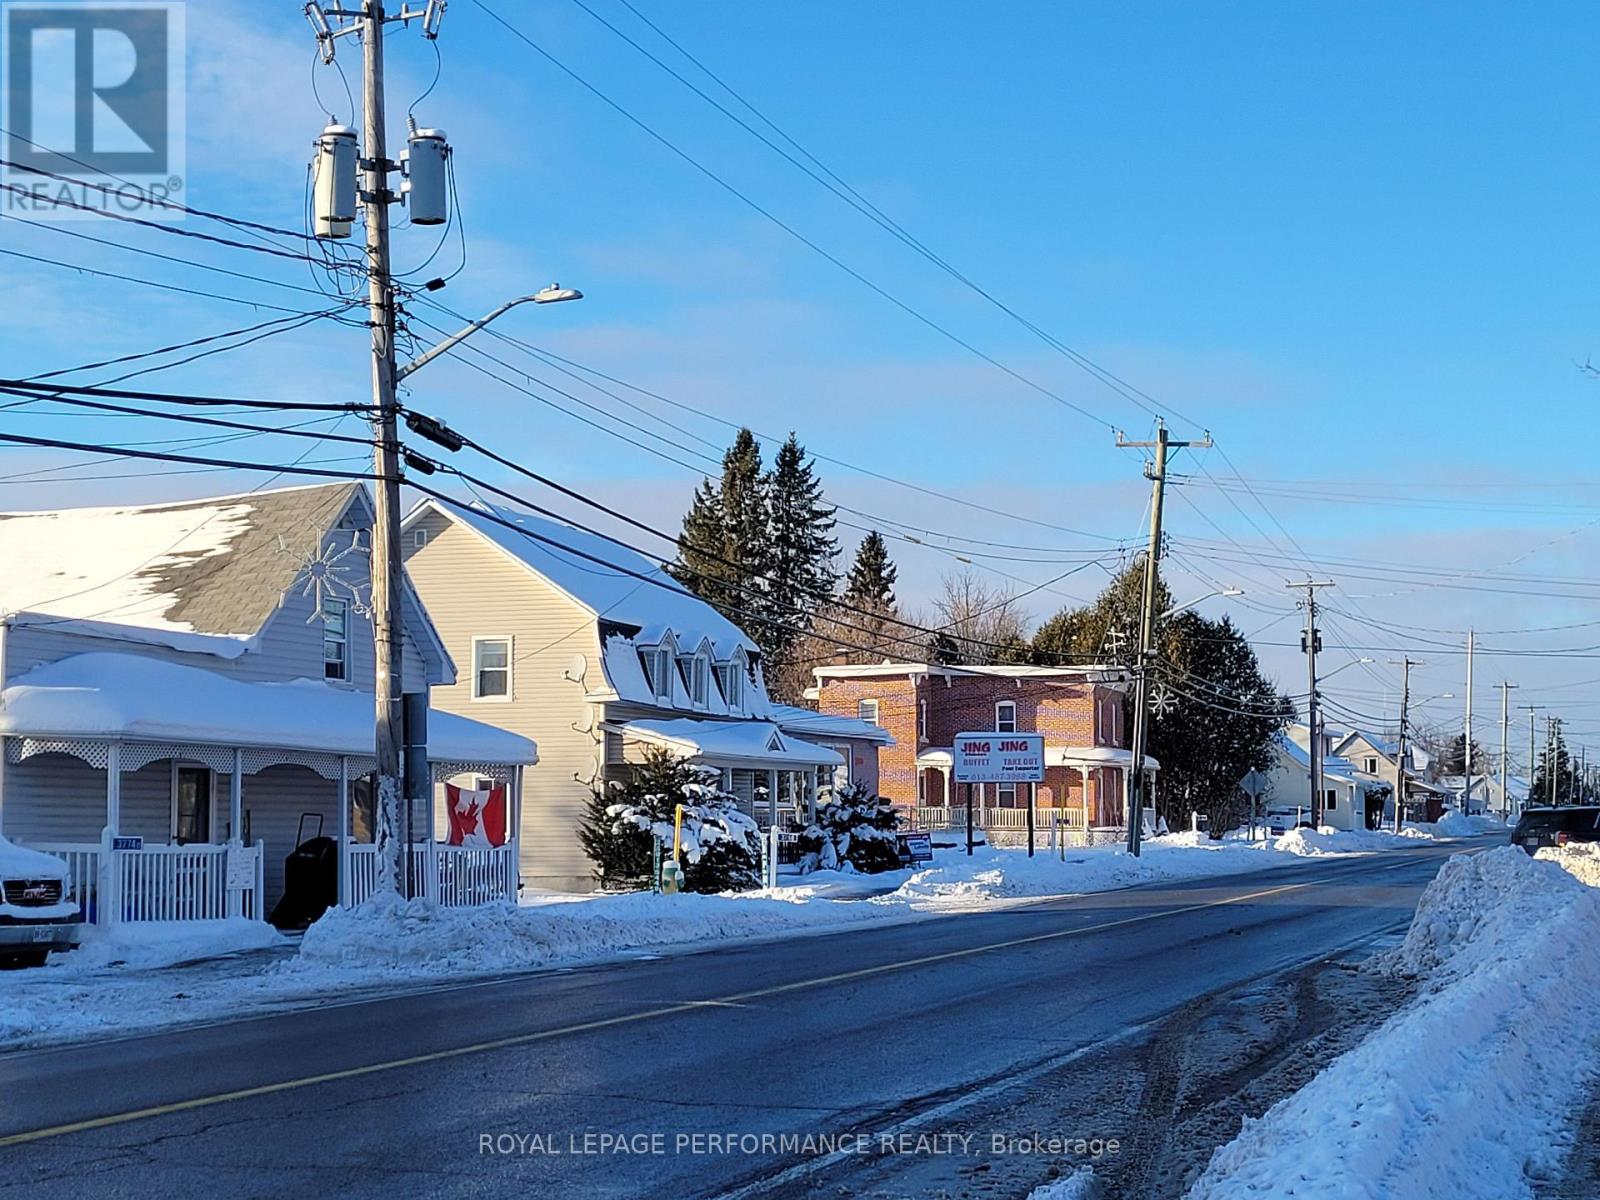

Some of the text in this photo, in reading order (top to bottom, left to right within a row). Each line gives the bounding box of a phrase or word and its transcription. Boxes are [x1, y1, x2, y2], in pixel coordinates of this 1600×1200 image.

[960, 741, 1029, 753] JING JING
[963, 757, 1038, 766] BUFFET TAKE OUT
